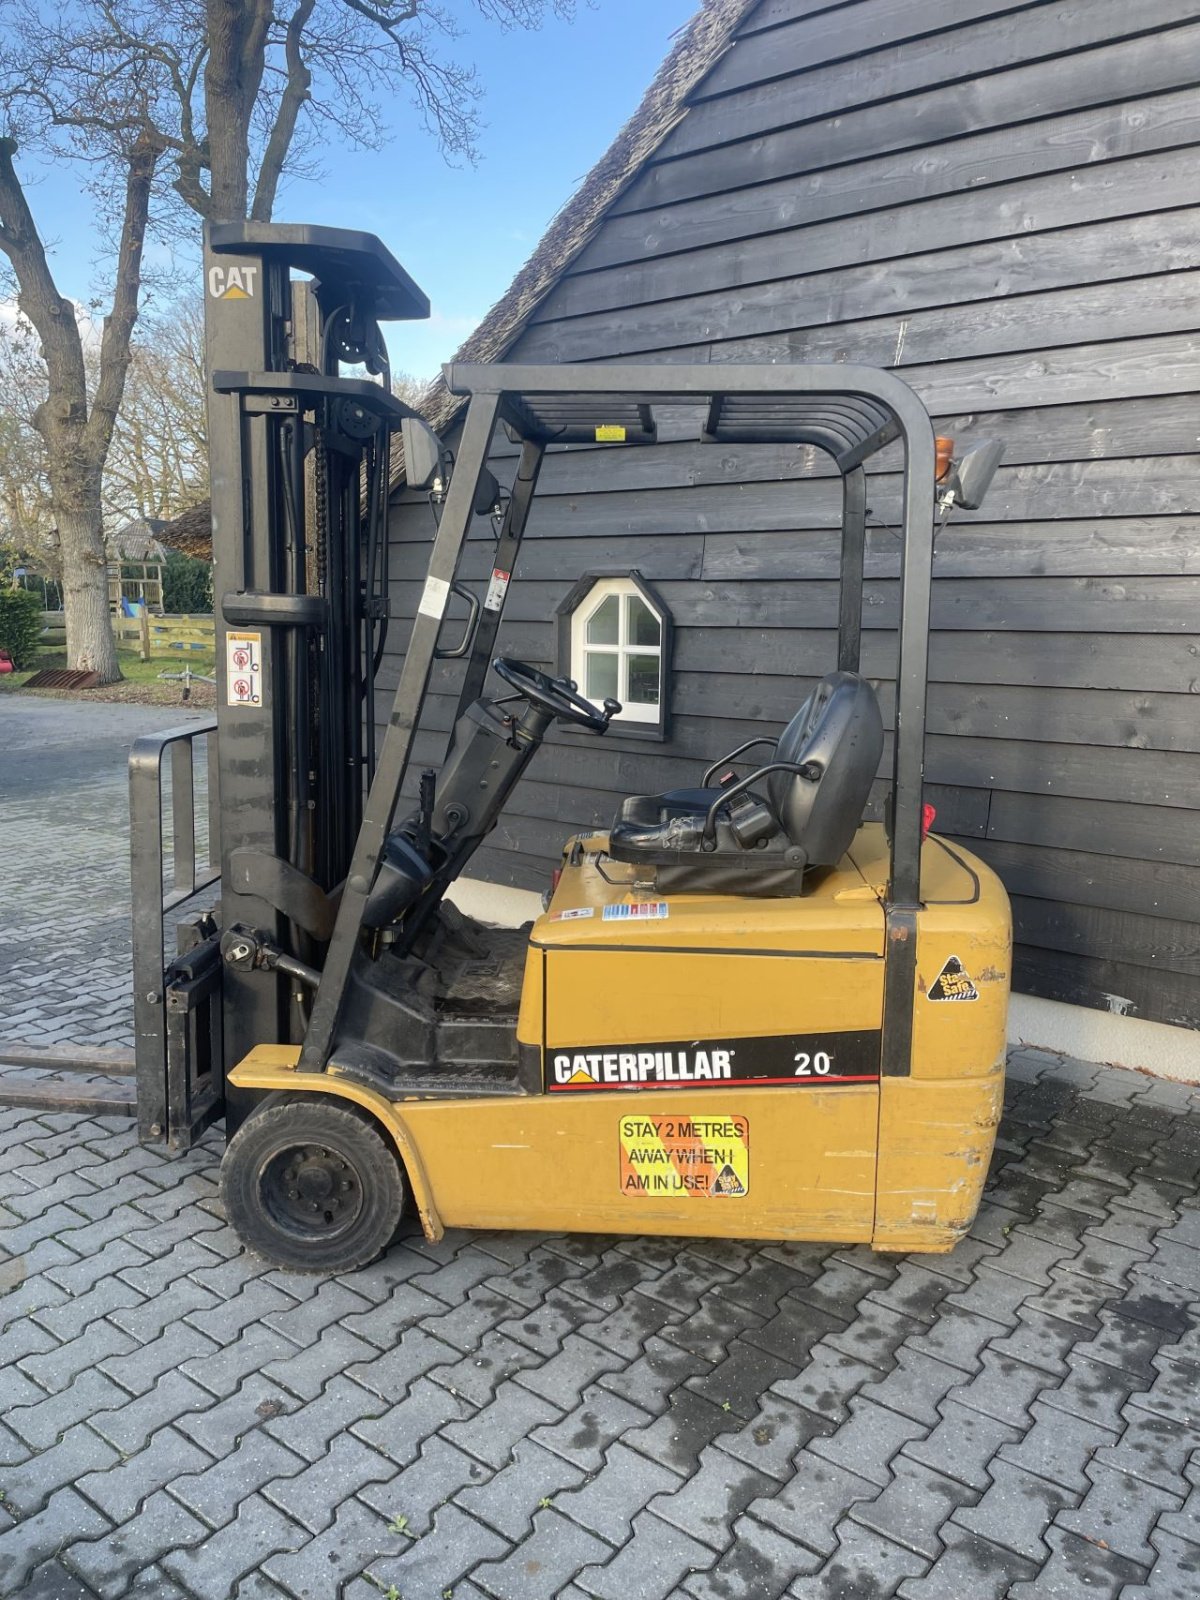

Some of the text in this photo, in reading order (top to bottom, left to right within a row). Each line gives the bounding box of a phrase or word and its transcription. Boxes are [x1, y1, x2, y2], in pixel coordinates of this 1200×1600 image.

[208, 266, 257, 298] CAT
[554, 1050, 831, 1083] CATERPILLAR 20
[623, 1122, 744, 1138] STAY 2 METRES
[628, 1148, 674, 1164] AWAY
[676, 1148, 725, 1164] WHEN
[625, 1174, 709, 1190] AM IN USE!
